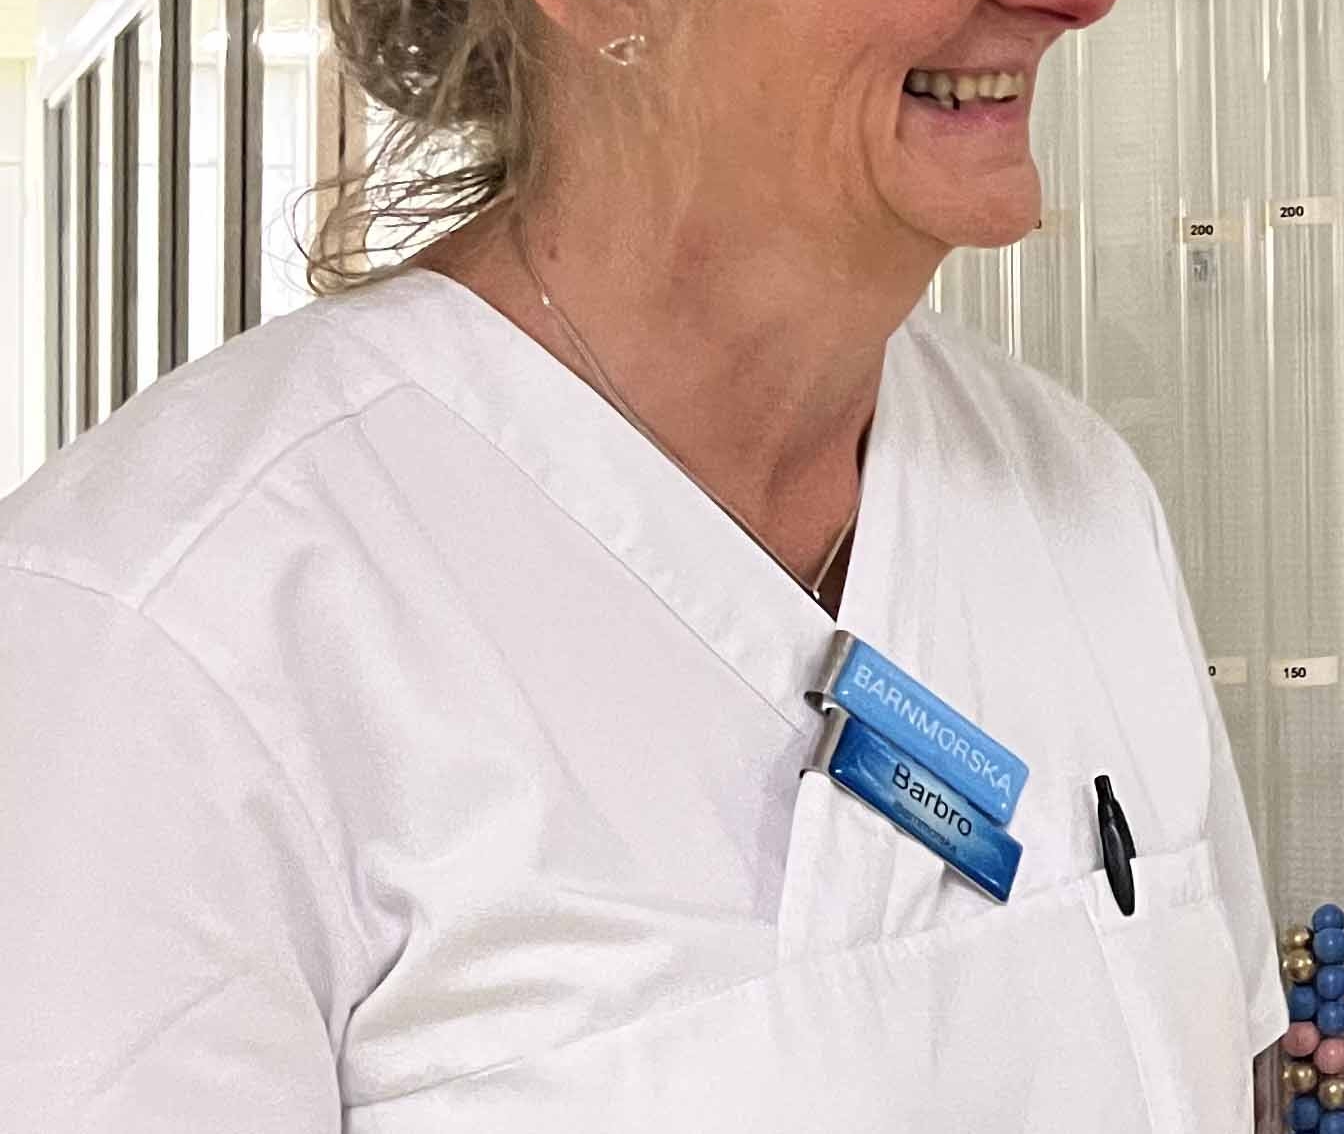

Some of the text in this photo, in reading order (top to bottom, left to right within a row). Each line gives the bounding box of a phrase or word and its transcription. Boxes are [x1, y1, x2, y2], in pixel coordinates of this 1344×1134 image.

[1279, 205, 1305, 218] 200
[1190, 224, 1214, 236] 200
[1283, 666, 1307, 679] 150
[854, 665, 1012, 796] BARNMORSKA
[892, 762, 972, 836] Barbro
